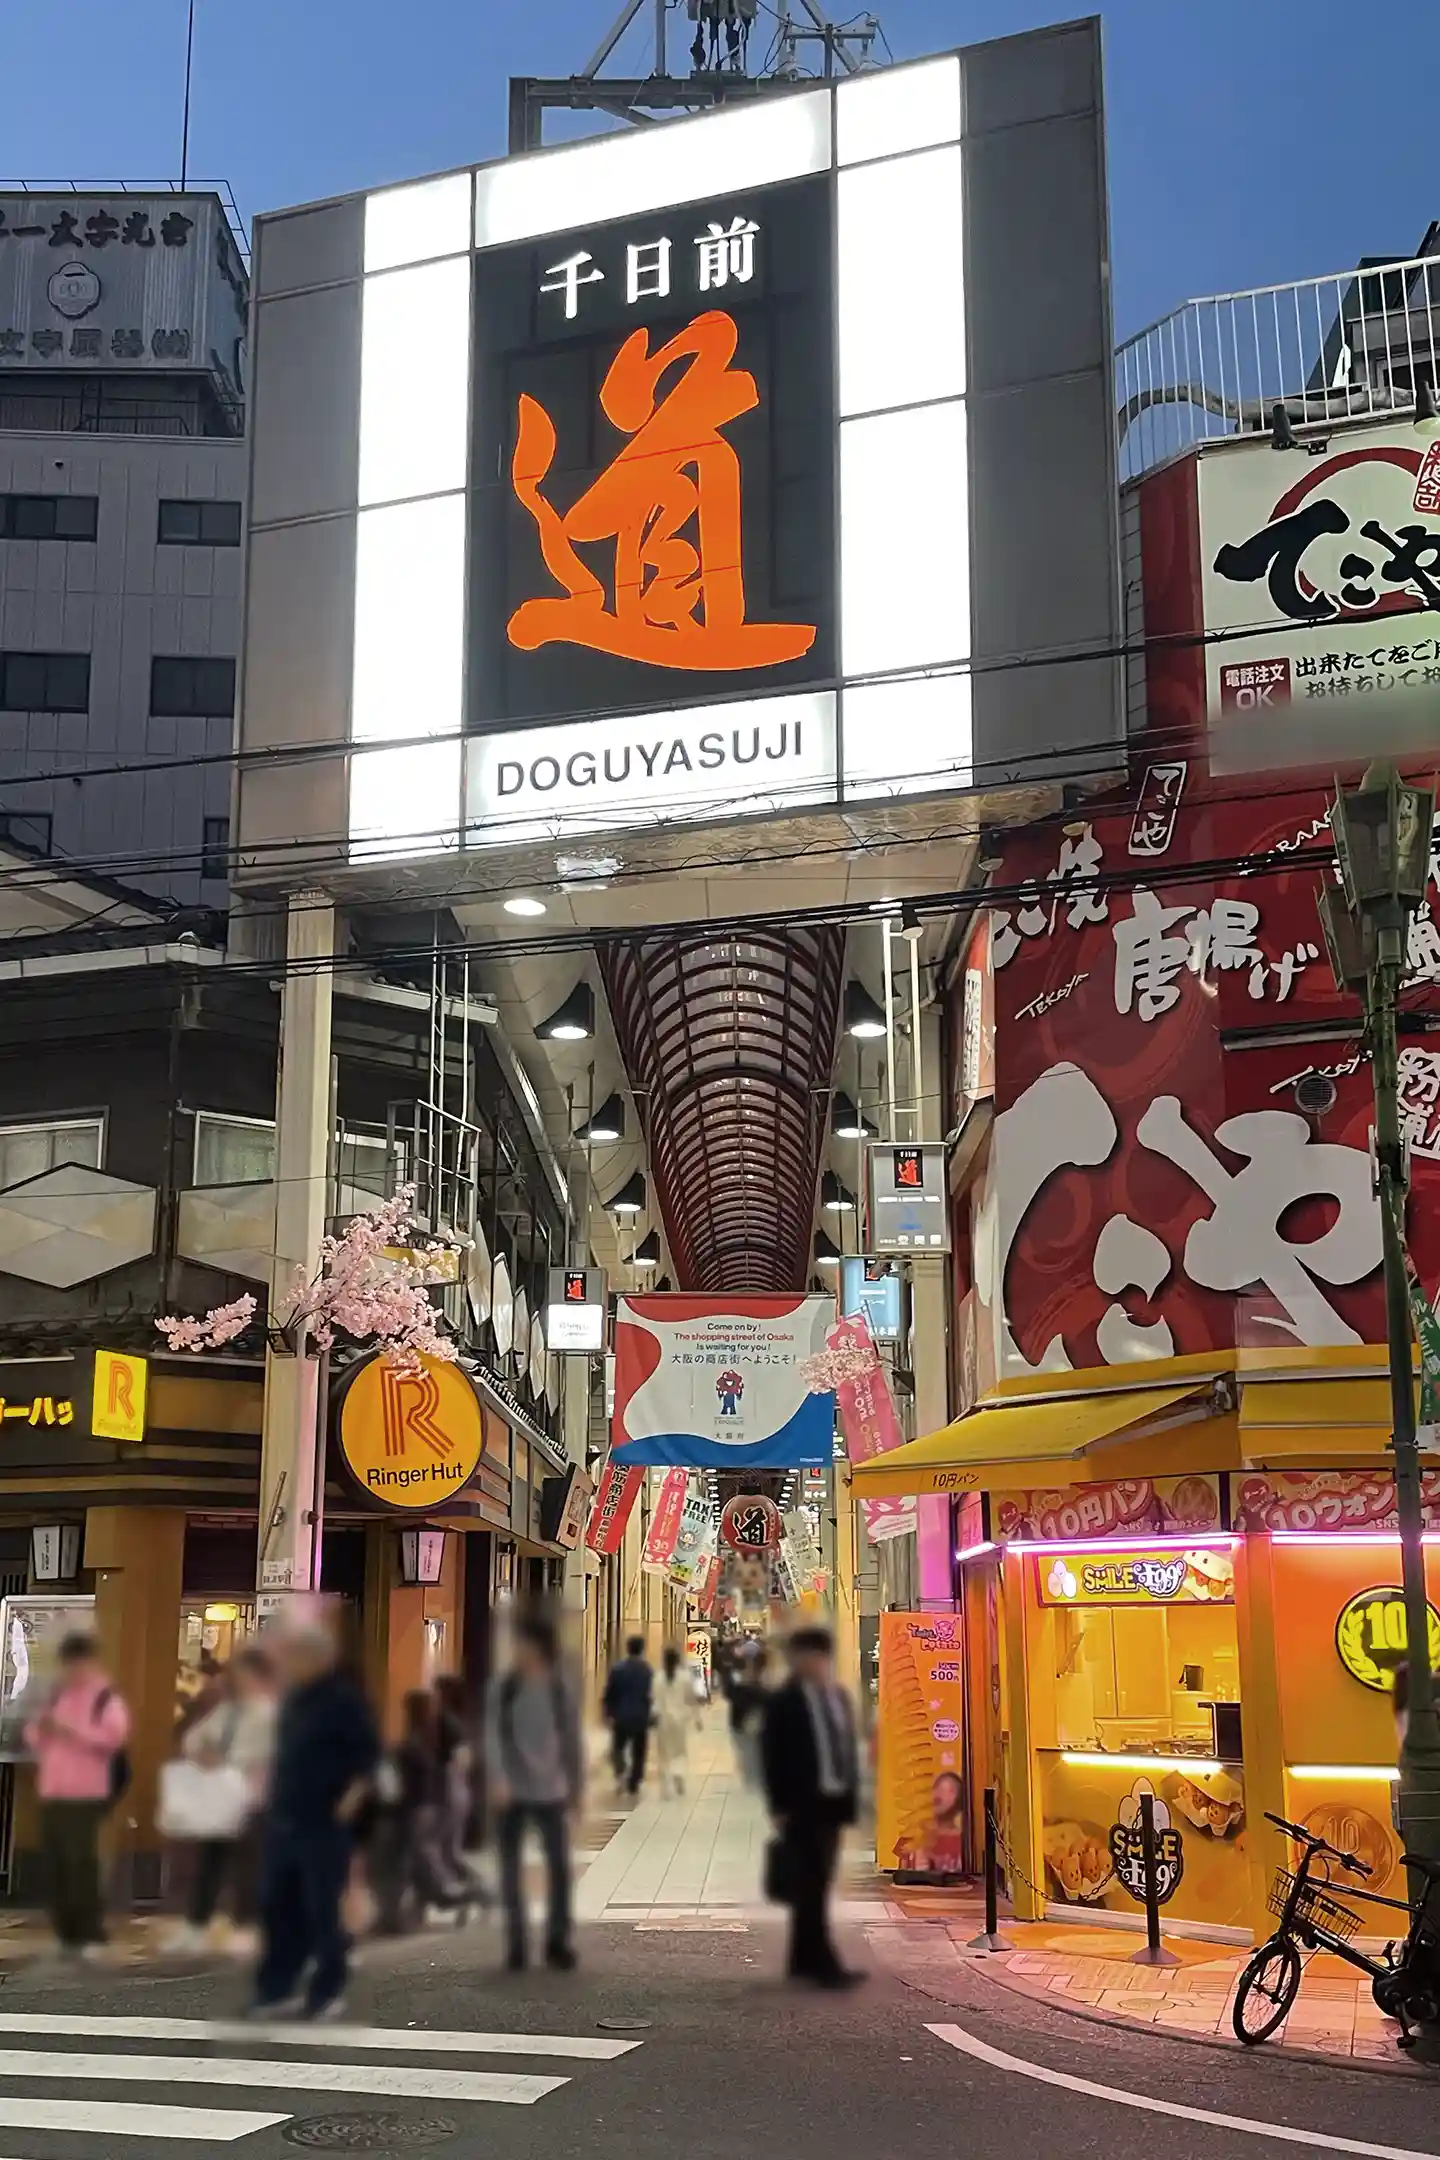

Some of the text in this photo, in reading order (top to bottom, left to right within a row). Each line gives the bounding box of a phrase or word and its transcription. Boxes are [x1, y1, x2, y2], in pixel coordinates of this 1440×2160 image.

[539, 215, 762, 321] 千日前
[506, 309, 818, 671] 道
[1225, 664, 1285, 687] 電話注文
[496, 721, 804, 798] DOGUYASUJI
[1112, 883, 1320, 1023] 唐揚げ
[674, 1332, 795, 1343] The shopping street of Osaka
[707, 1322, 733, 1331] Come
[705, 1343, 736, 1352] waiting
[737, 1343, 750, 1351] for
[109, 1360, 135, 1421] R
[0, 1396, 74, 1426] ーハッ
[380, 1366, 455, 1459] R
[366, 1462, 465, 1488] Ringer Hut
[932, 1472, 980, 1488] 10円パン
[682, 1508, 708, 1525] FREE
[685, 1497, 710, 1517] TAX
[1365, 1601, 1409, 1649] 10
